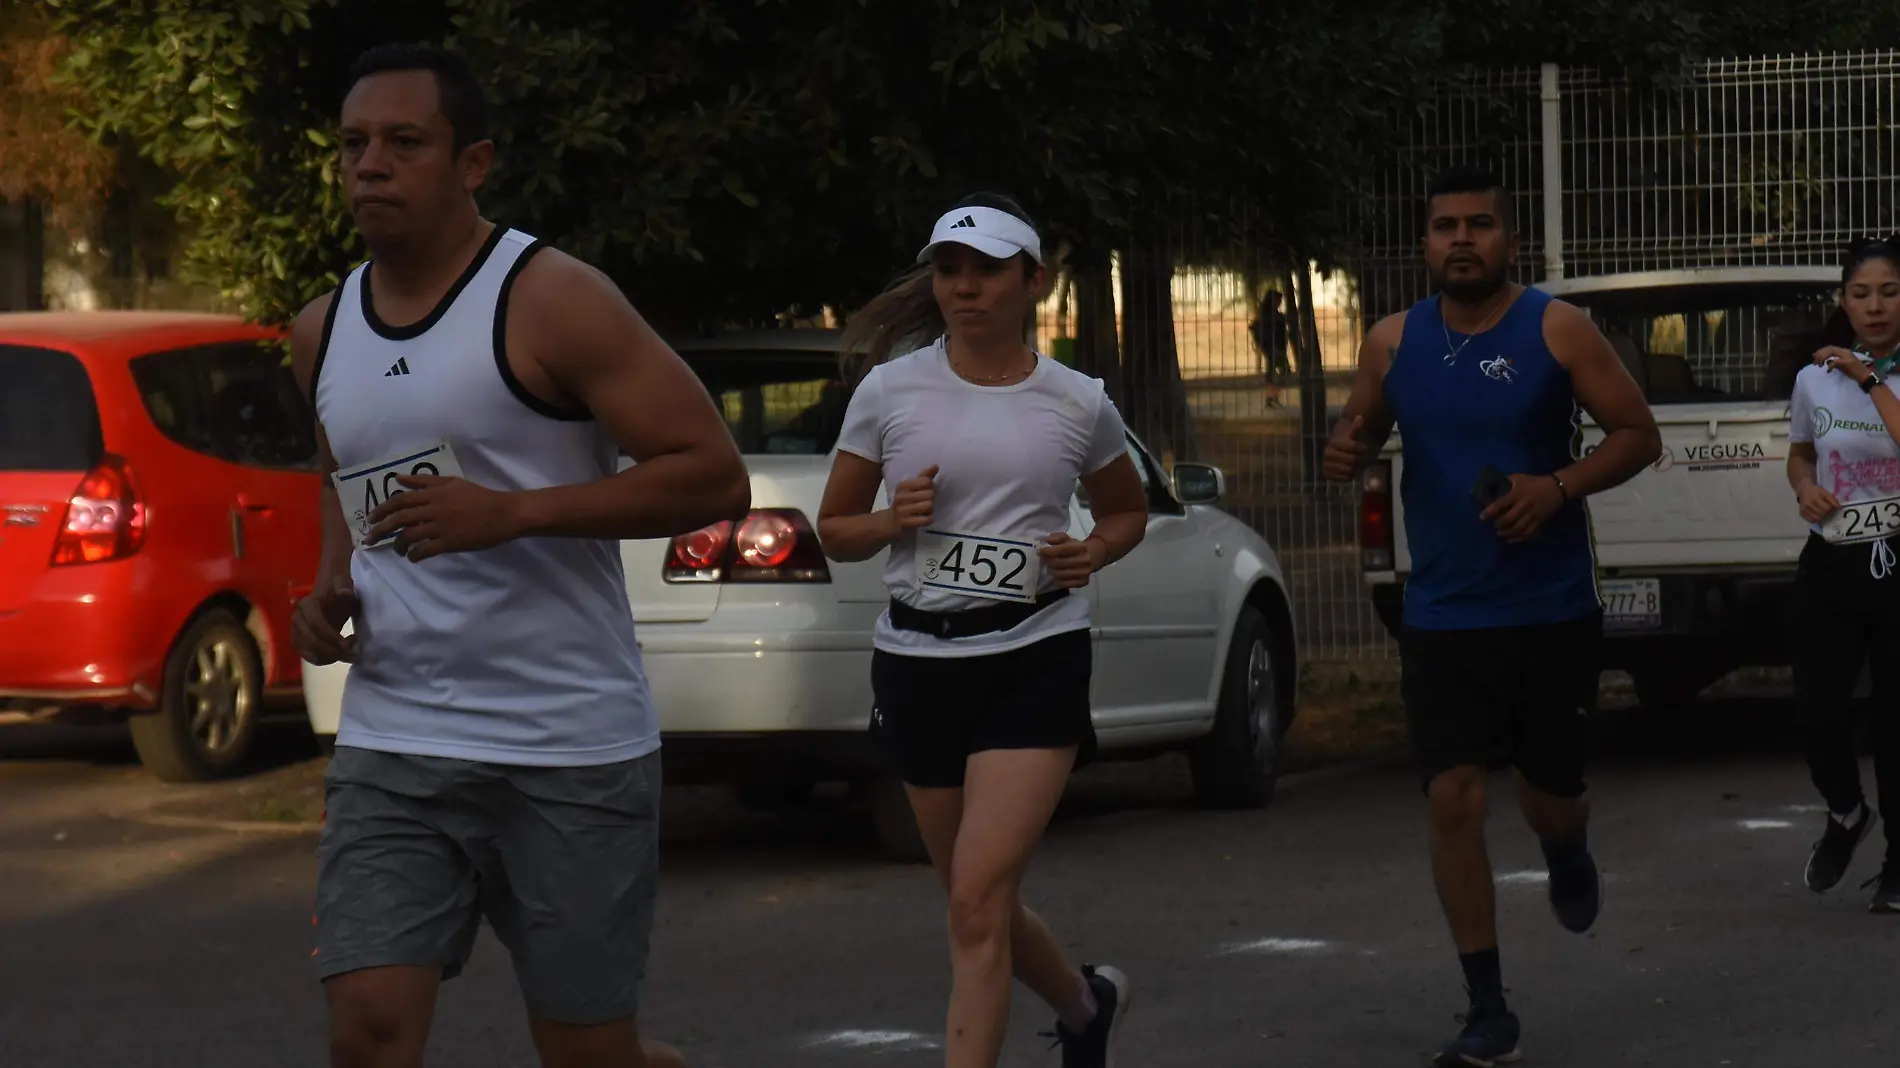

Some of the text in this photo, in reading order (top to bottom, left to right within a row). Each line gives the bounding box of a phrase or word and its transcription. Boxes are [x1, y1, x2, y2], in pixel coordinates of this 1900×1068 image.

[1685, 443, 1764, 460] VEGUSA
[1843, 502, 1900, 537] 243
[939, 541, 1026, 590] 452
[1603, 591, 1656, 613] 777-B
